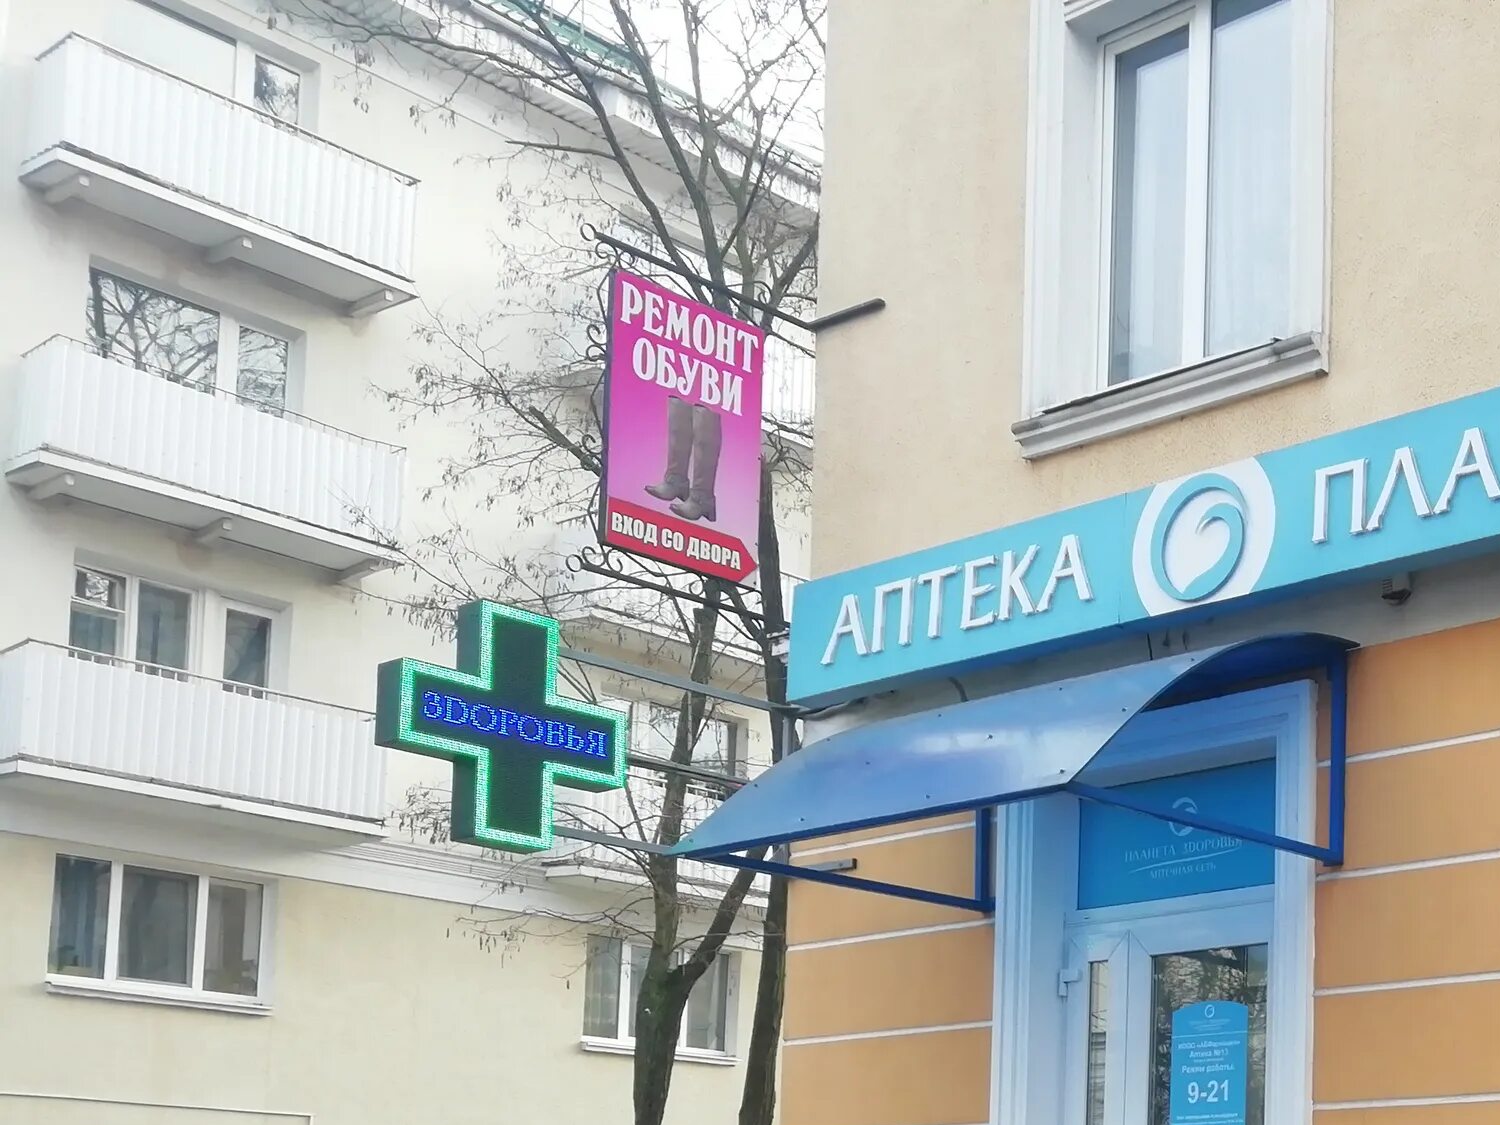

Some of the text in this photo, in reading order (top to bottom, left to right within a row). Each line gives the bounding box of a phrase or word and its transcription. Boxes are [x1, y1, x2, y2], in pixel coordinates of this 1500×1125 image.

[620, 281, 759, 373] РЕМОНТ
[632, 337, 743, 416] ОБУВИ
[611, 512, 742, 571] ВХОД СО ДВОРА
[820, 534, 1094, 666] АПТЕКА
[424, 691, 607, 757] ЗДОРОВЬЯ
[1187, 1079, 1230, 1104] 9-21
